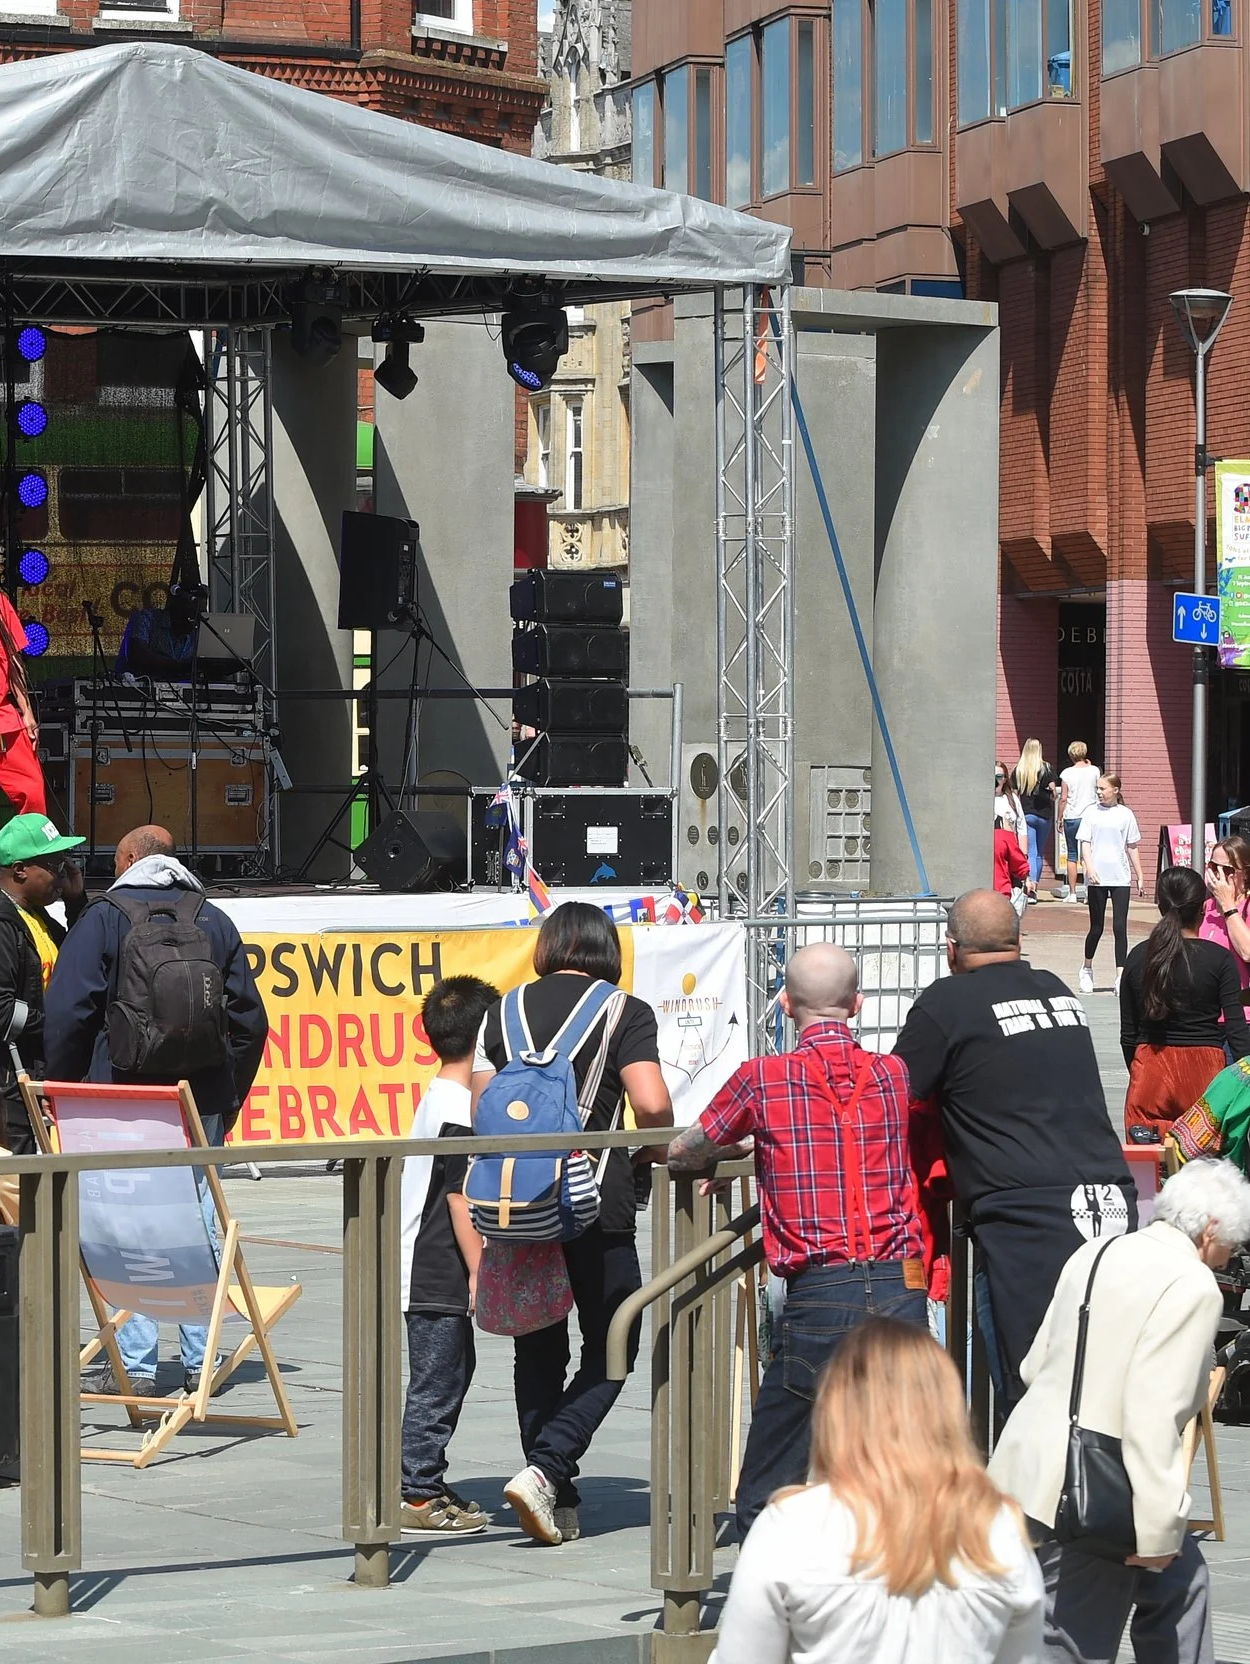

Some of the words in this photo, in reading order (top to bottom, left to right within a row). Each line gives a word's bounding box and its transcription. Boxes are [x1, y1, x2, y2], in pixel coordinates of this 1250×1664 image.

[111, 581, 171, 618] CO
[1058, 627, 1106, 643] DEB
[1061, 671, 1092, 696] COSTA
[243, 942, 443, 997] PSWICH
[662, 996, 718, 1014] WINDRUSH
[265, 1013, 439, 1069] NDRUS
[1101, 1184, 1113, 1201] 2
